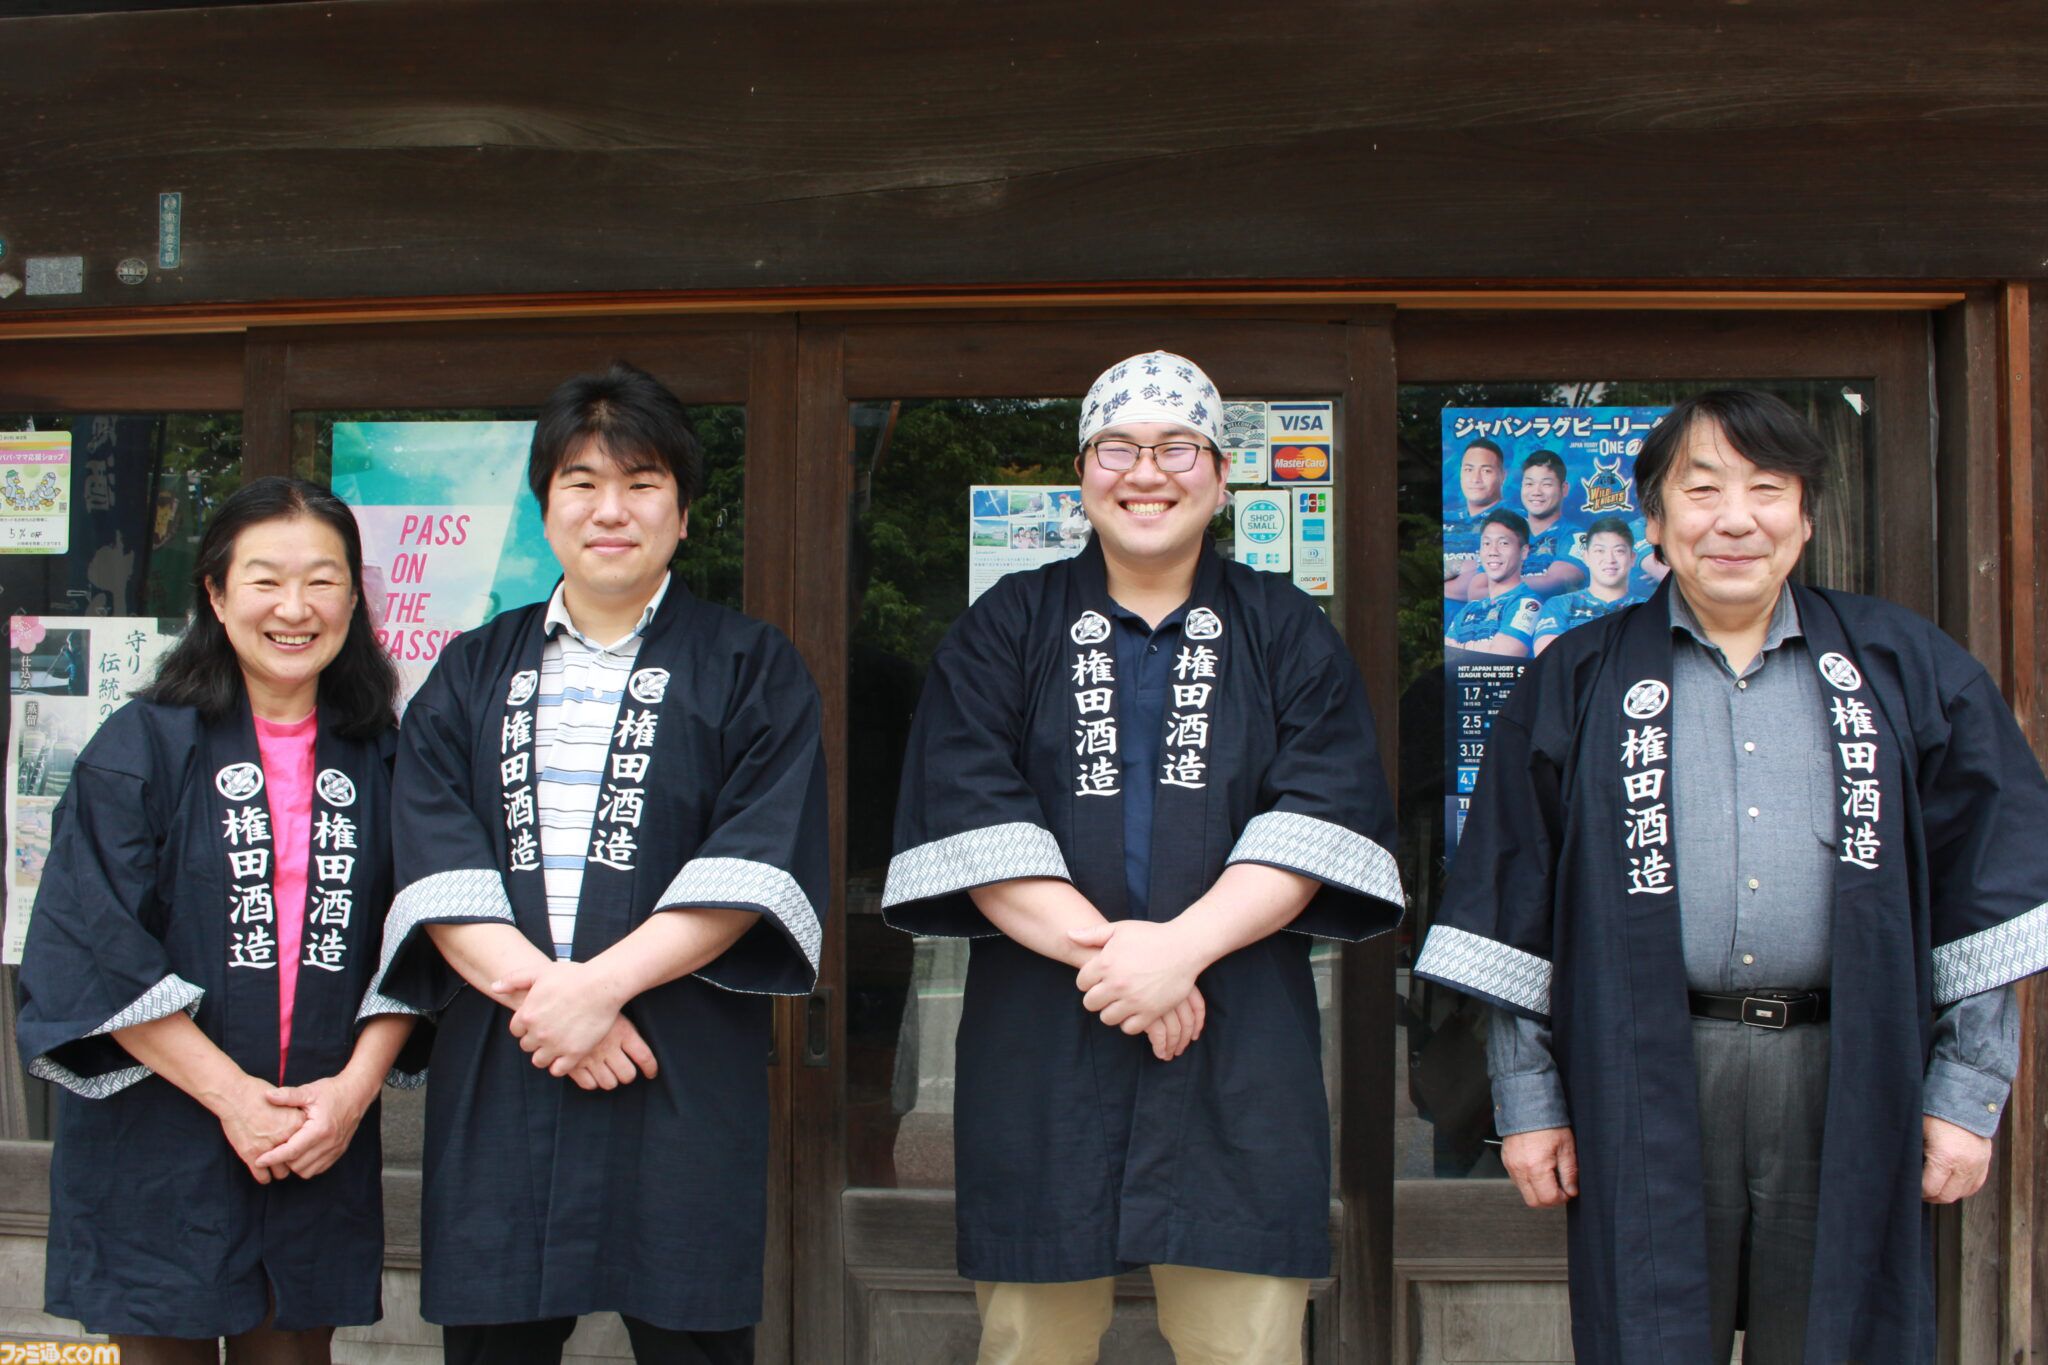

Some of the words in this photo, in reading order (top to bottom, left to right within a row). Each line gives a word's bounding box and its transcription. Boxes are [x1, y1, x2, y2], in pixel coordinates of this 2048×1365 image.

[1279, 415, 1323, 431] VISA
[1454, 416, 1665, 438] ジャパンラグビーリー
[1274, 458, 1327, 468] MasterCard
[1600, 438, 1625, 456] ONE
[399, 514, 471, 546] PASS
[1248, 522, 1277, 530] SMALL
[1250, 514, 1275, 522] SHOP
[390, 553, 427, 584] ON
[383, 592, 431, 623] THE
[125, 629, 147, 675] 守り
[374, 629, 464, 661] PASSI
[21, 655, 32, 689] 仕込み
[99, 653, 121, 725] 伝統の
[1464, 687, 1481, 700] 1.7
[1071, 649, 1120, 797] 権田酒造
[1159, 645, 1219, 789] 権田酒造
[1462, 715, 1482, 728] 2.5
[1460, 744, 1484, 757] 3.12
[501, 710, 541, 872] 権田酒造
[587, 709, 659, 871] 権田酒造
[1830, 696, 1881, 870] 権田酒造
[1620, 725, 1674, 895] 権田酒造
[221, 806, 277, 970] 権田酒造
[302, 810, 358, 972] 権田酒造
